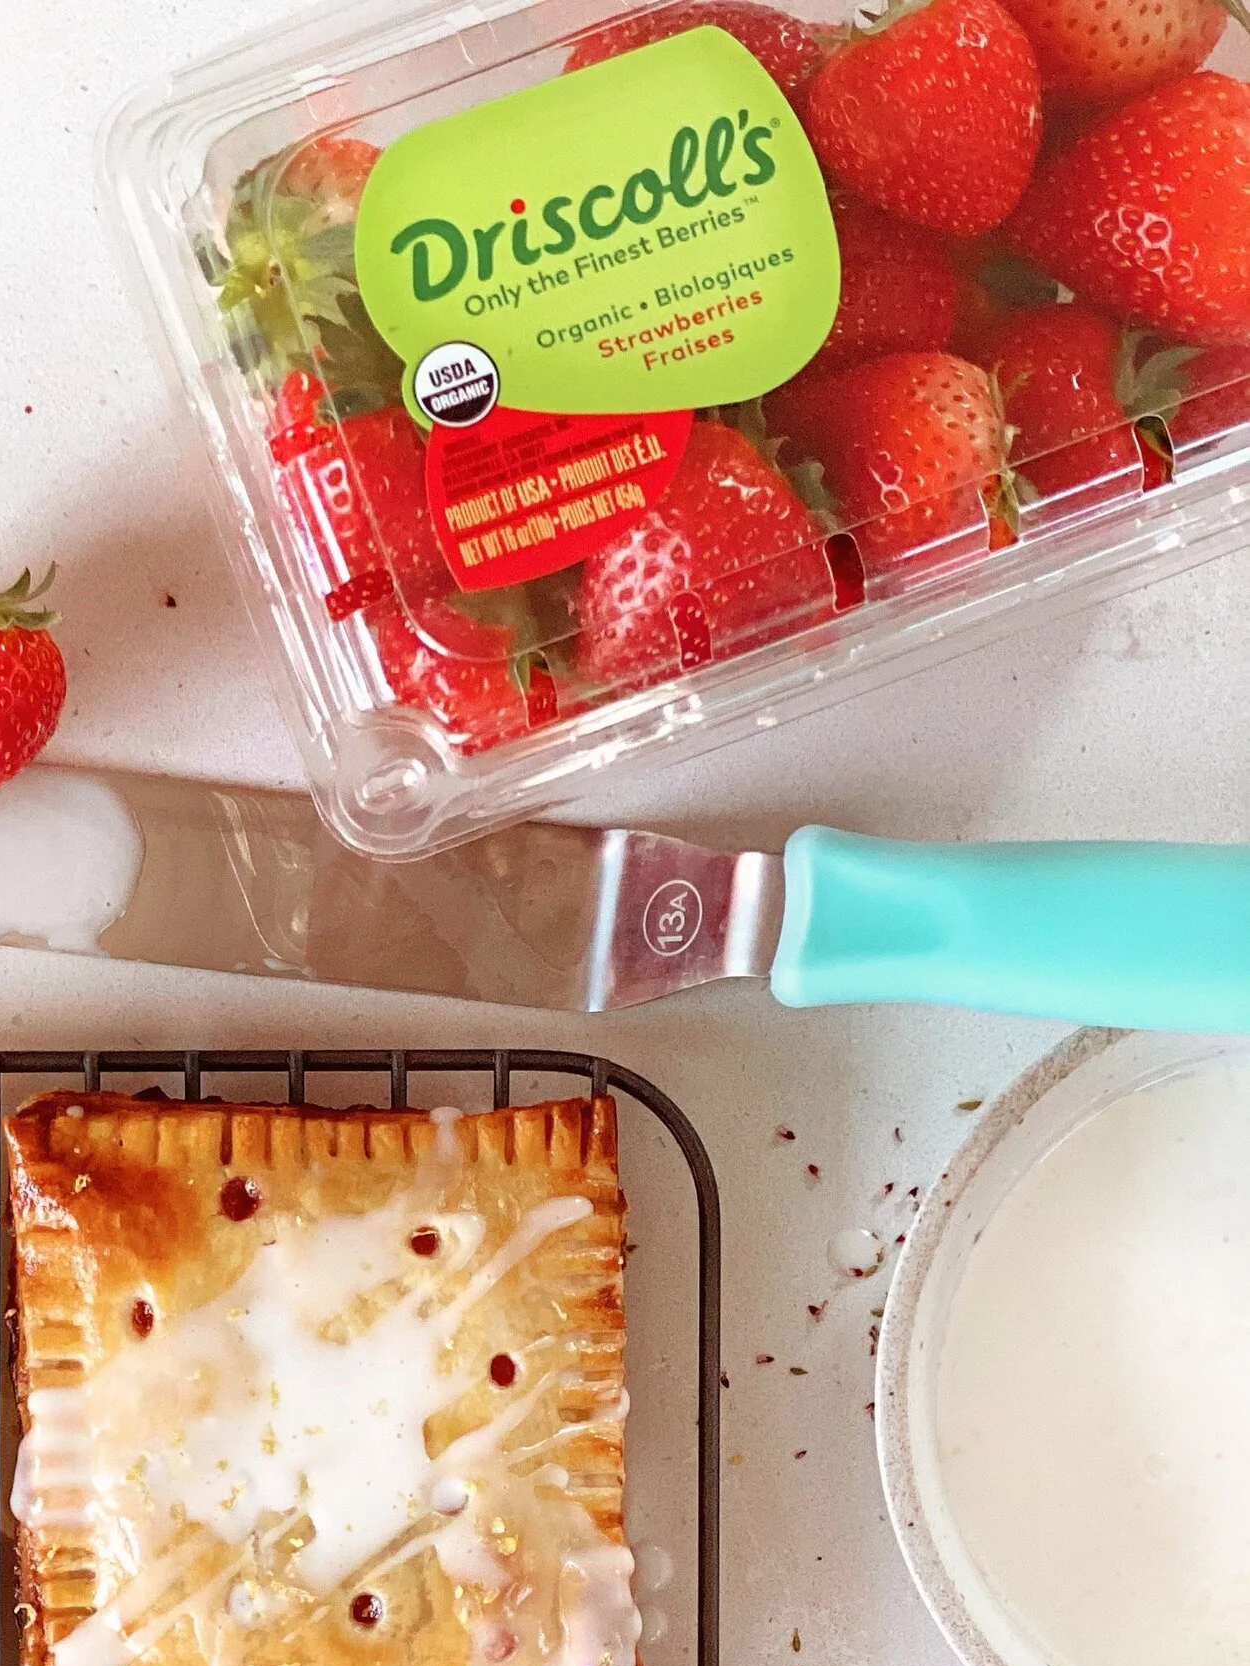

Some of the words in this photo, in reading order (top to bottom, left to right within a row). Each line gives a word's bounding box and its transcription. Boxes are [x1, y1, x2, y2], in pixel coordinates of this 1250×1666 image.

[464, 284, 522, 318] Only
[527, 265, 570, 296] the
[574, 237, 653, 280] Finest
[536, 303, 633, 350] Organic
[655, 247, 795, 307] Biologiques
[598, 288, 763, 358] Strawberries
[642, 327, 735, 371] Fraises
[428, 357, 477, 389] USDA
[430, 378, 490, 413] ORGANIC
[445, 492, 501, 533] PRODUCT
[500, 487, 516, 514] OF
[516, 475, 553, 508] USA
[558, 452, 612, 492] PRODUIT
[611, 444, 633, 473] DES
[459, 539, 483, 568] NET
[481, 533, 503, 560] WT
[500, 526, 517, 552] 16
[558, 501, 598, 533] POIDS
[597, 493, 618, 521] NET
[616, 480, 646, 511] 454g
[655, 891, 689, 950] 13A
